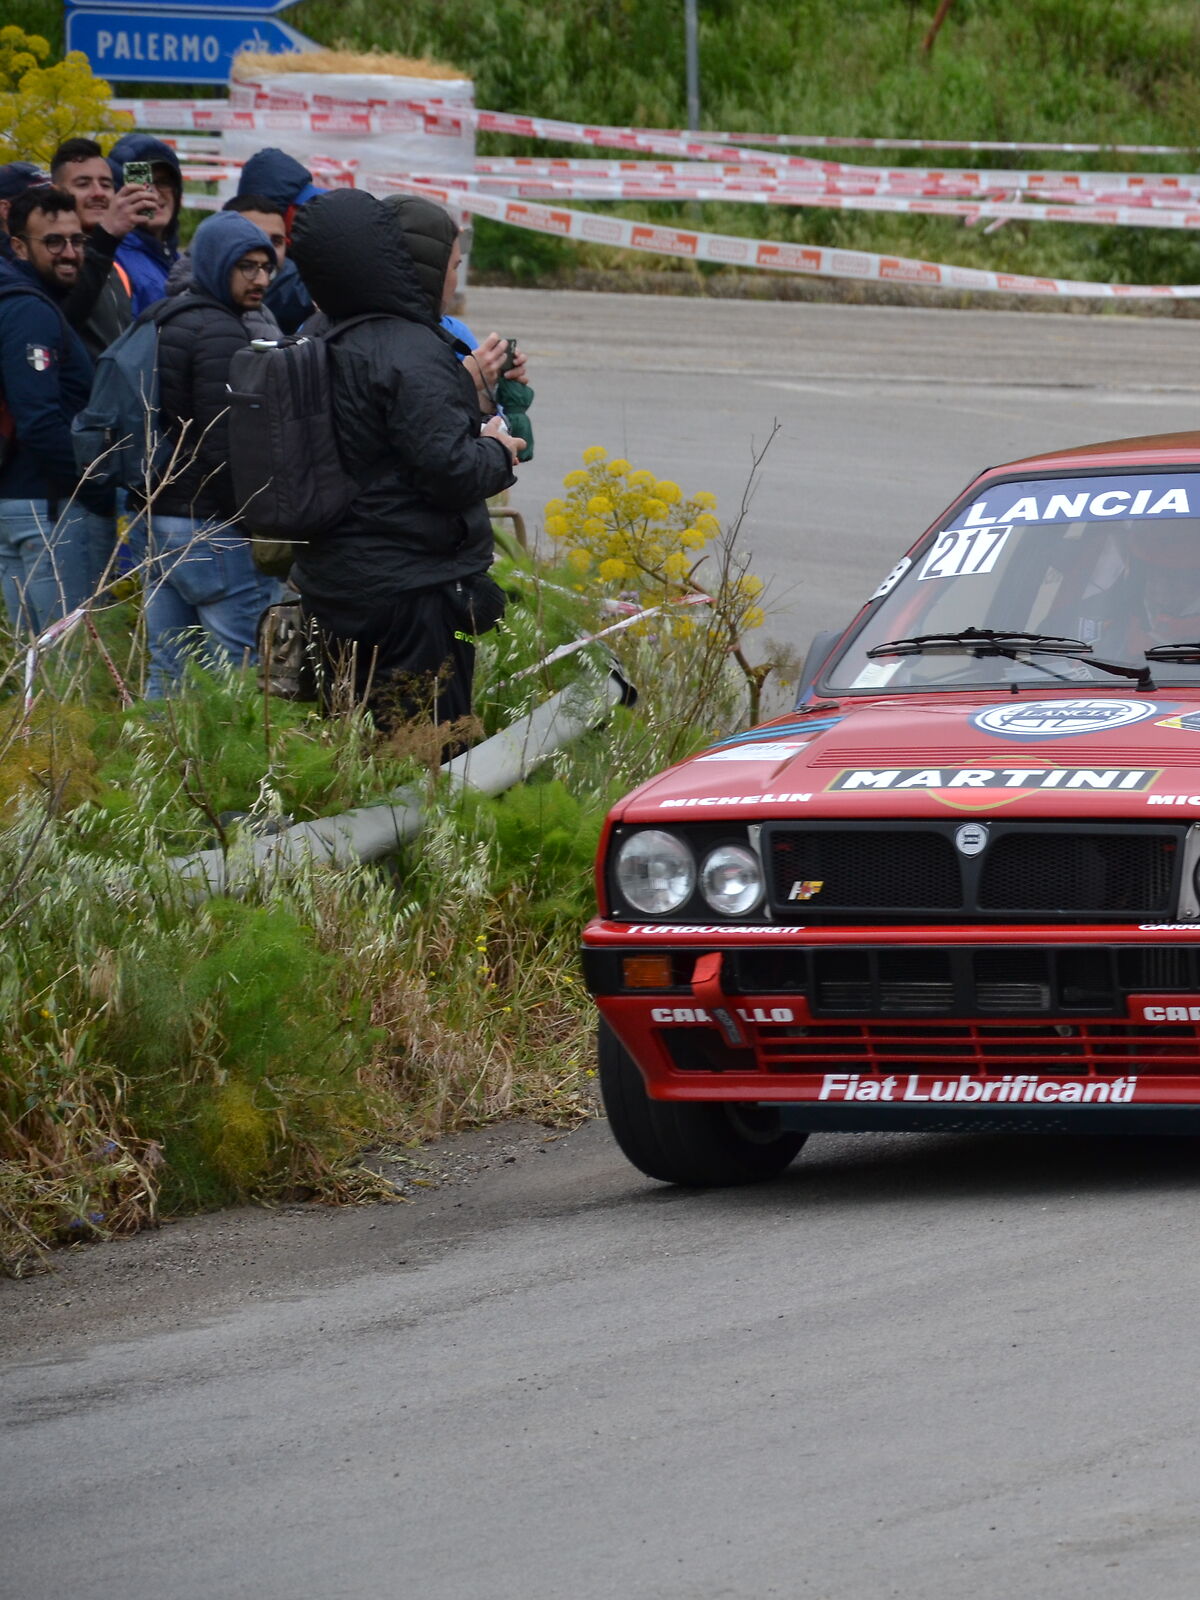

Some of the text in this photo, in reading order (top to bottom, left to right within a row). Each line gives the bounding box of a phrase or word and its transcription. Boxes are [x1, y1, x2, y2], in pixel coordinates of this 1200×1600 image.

[97, 30, 219, 63] PALERMO
[963, 488, 1190, 527] LANCIA
[921, 528, 1007, 578] 217
[1026, 709, 1111, 717] LANCIA
[841, 768, 1146, 790] MARTINI
[659, 793, 812, 808] MICHELIN
[788, 881, 825, 901] HF
[650, 1008, 794, 1023] CARLLO
[818, 1073, 1138, 1104] Fiat Lubrificanti
